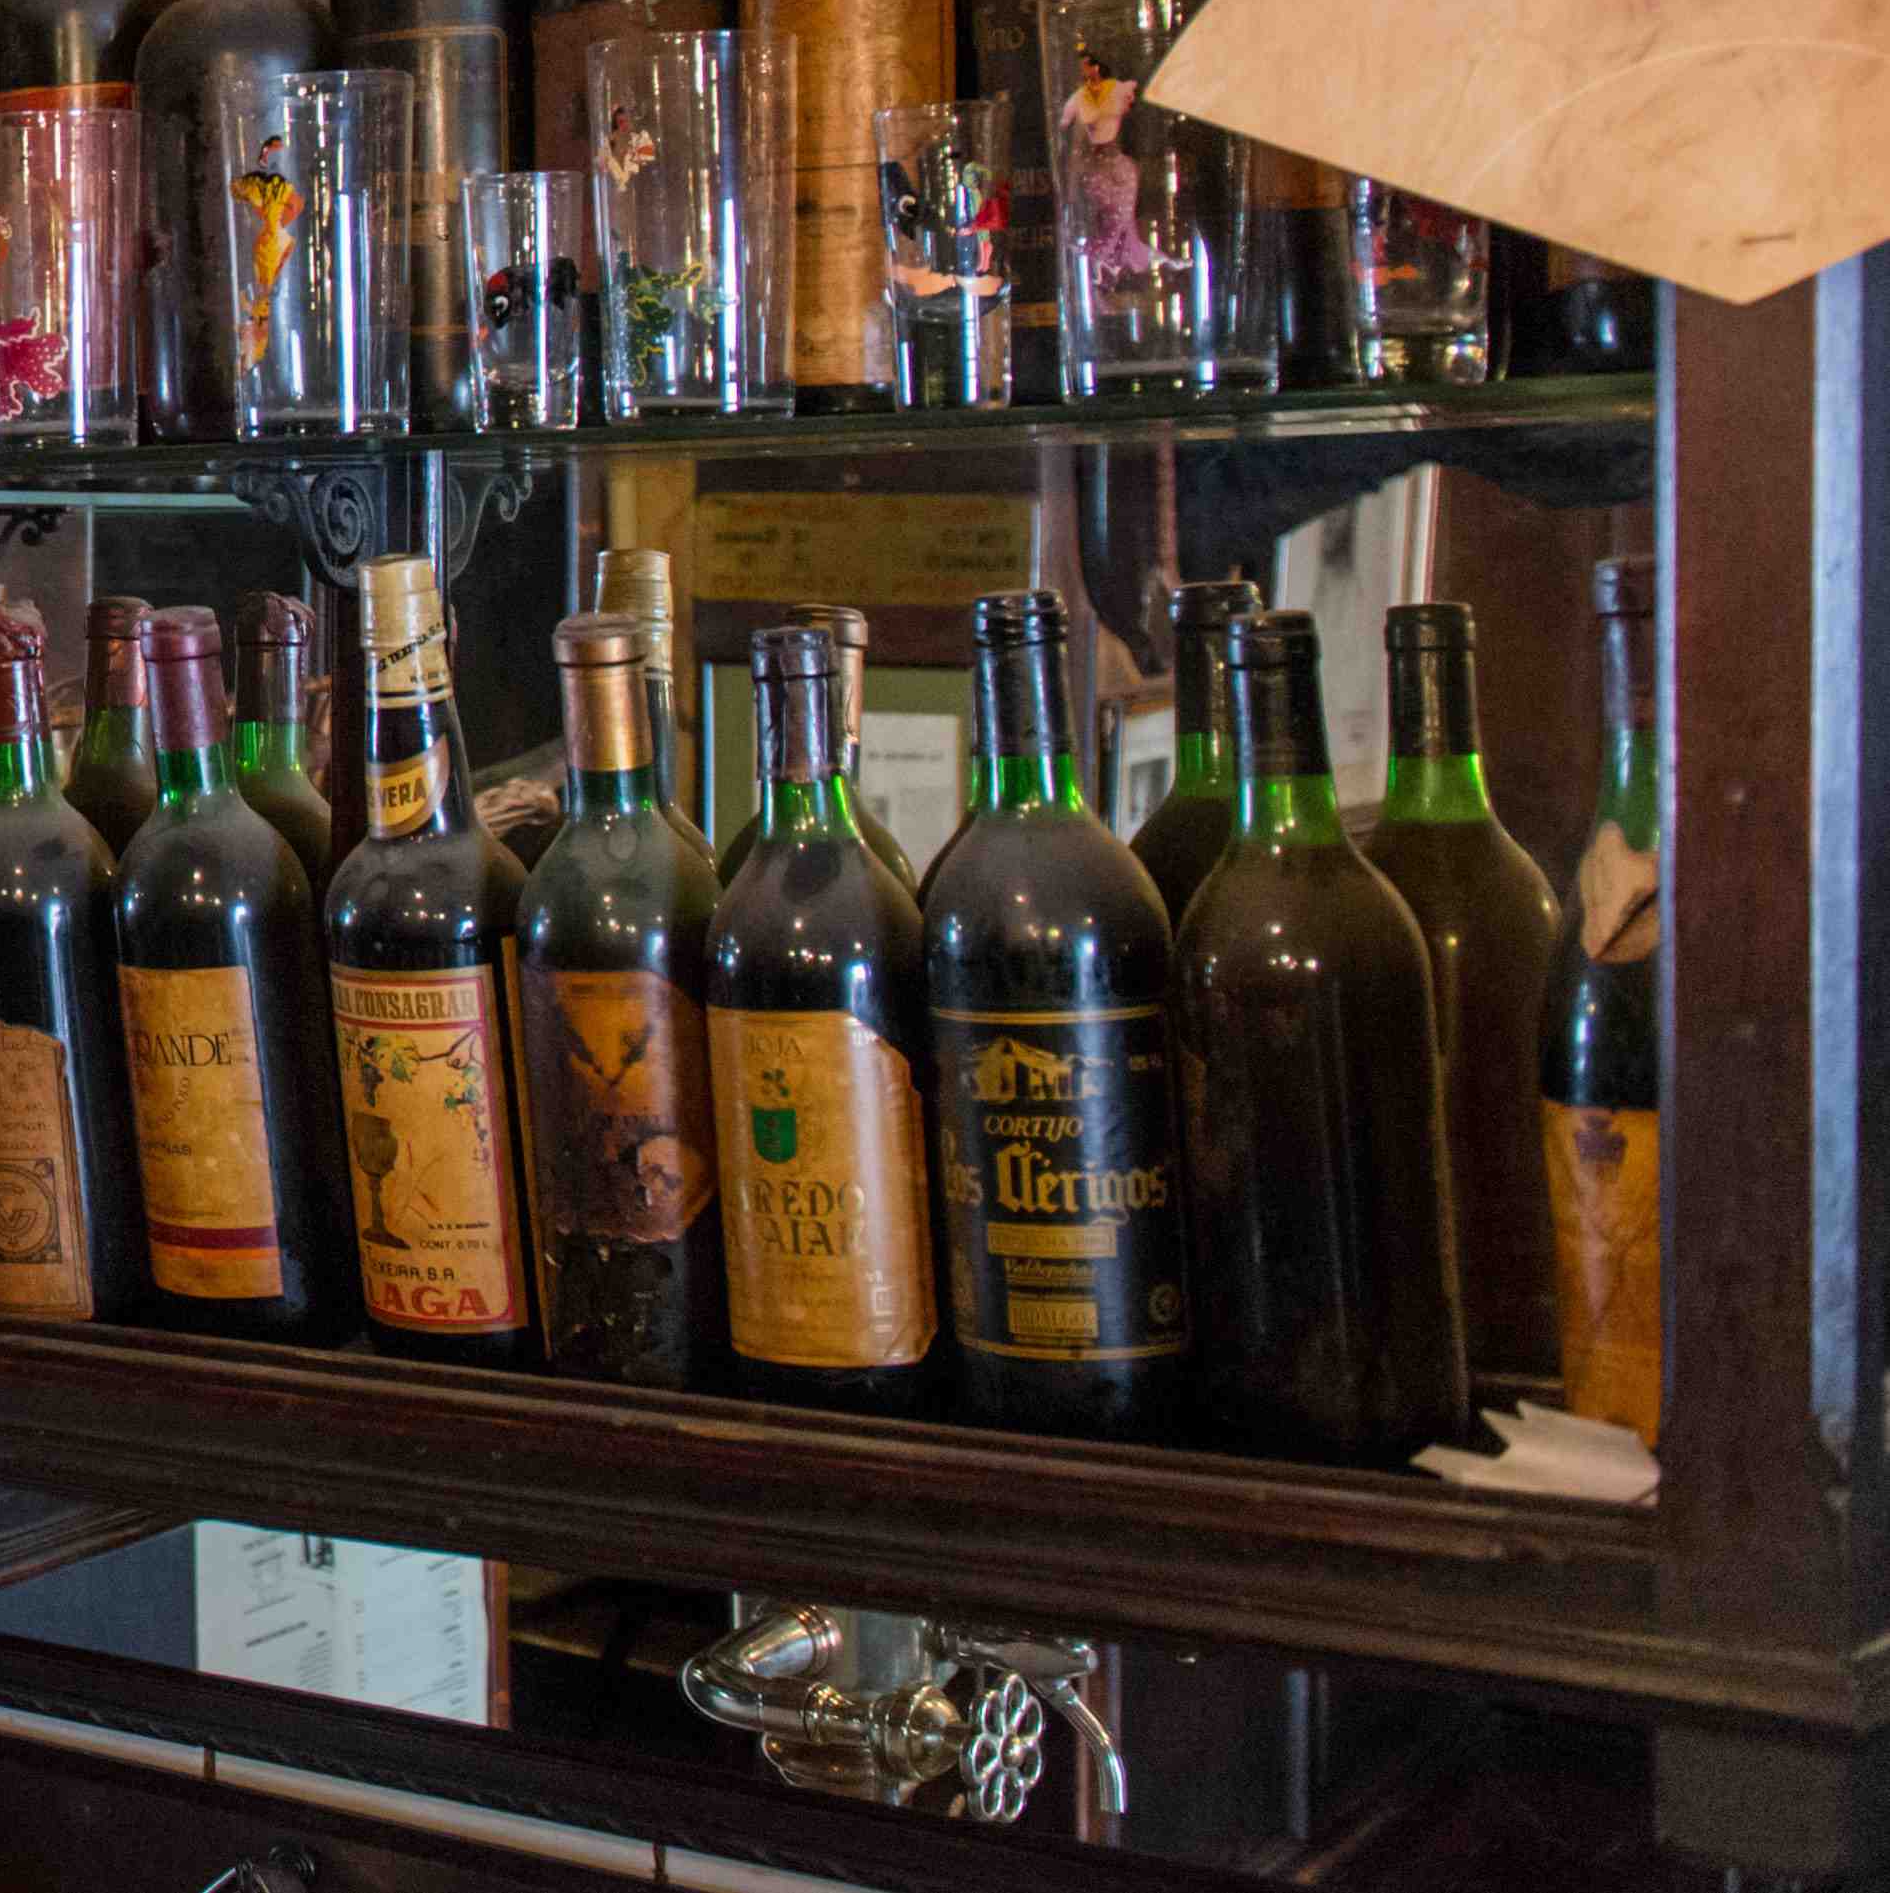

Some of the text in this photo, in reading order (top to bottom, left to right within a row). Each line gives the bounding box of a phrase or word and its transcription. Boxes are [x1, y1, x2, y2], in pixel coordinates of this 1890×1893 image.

[354, 986, 478, 1022] CONSAGRAR
[132, 1032, 233, 1068] RANDE
[746, 1034, 803, 1058] IOJA
[369, 1282, 491, 1318] LAGA
